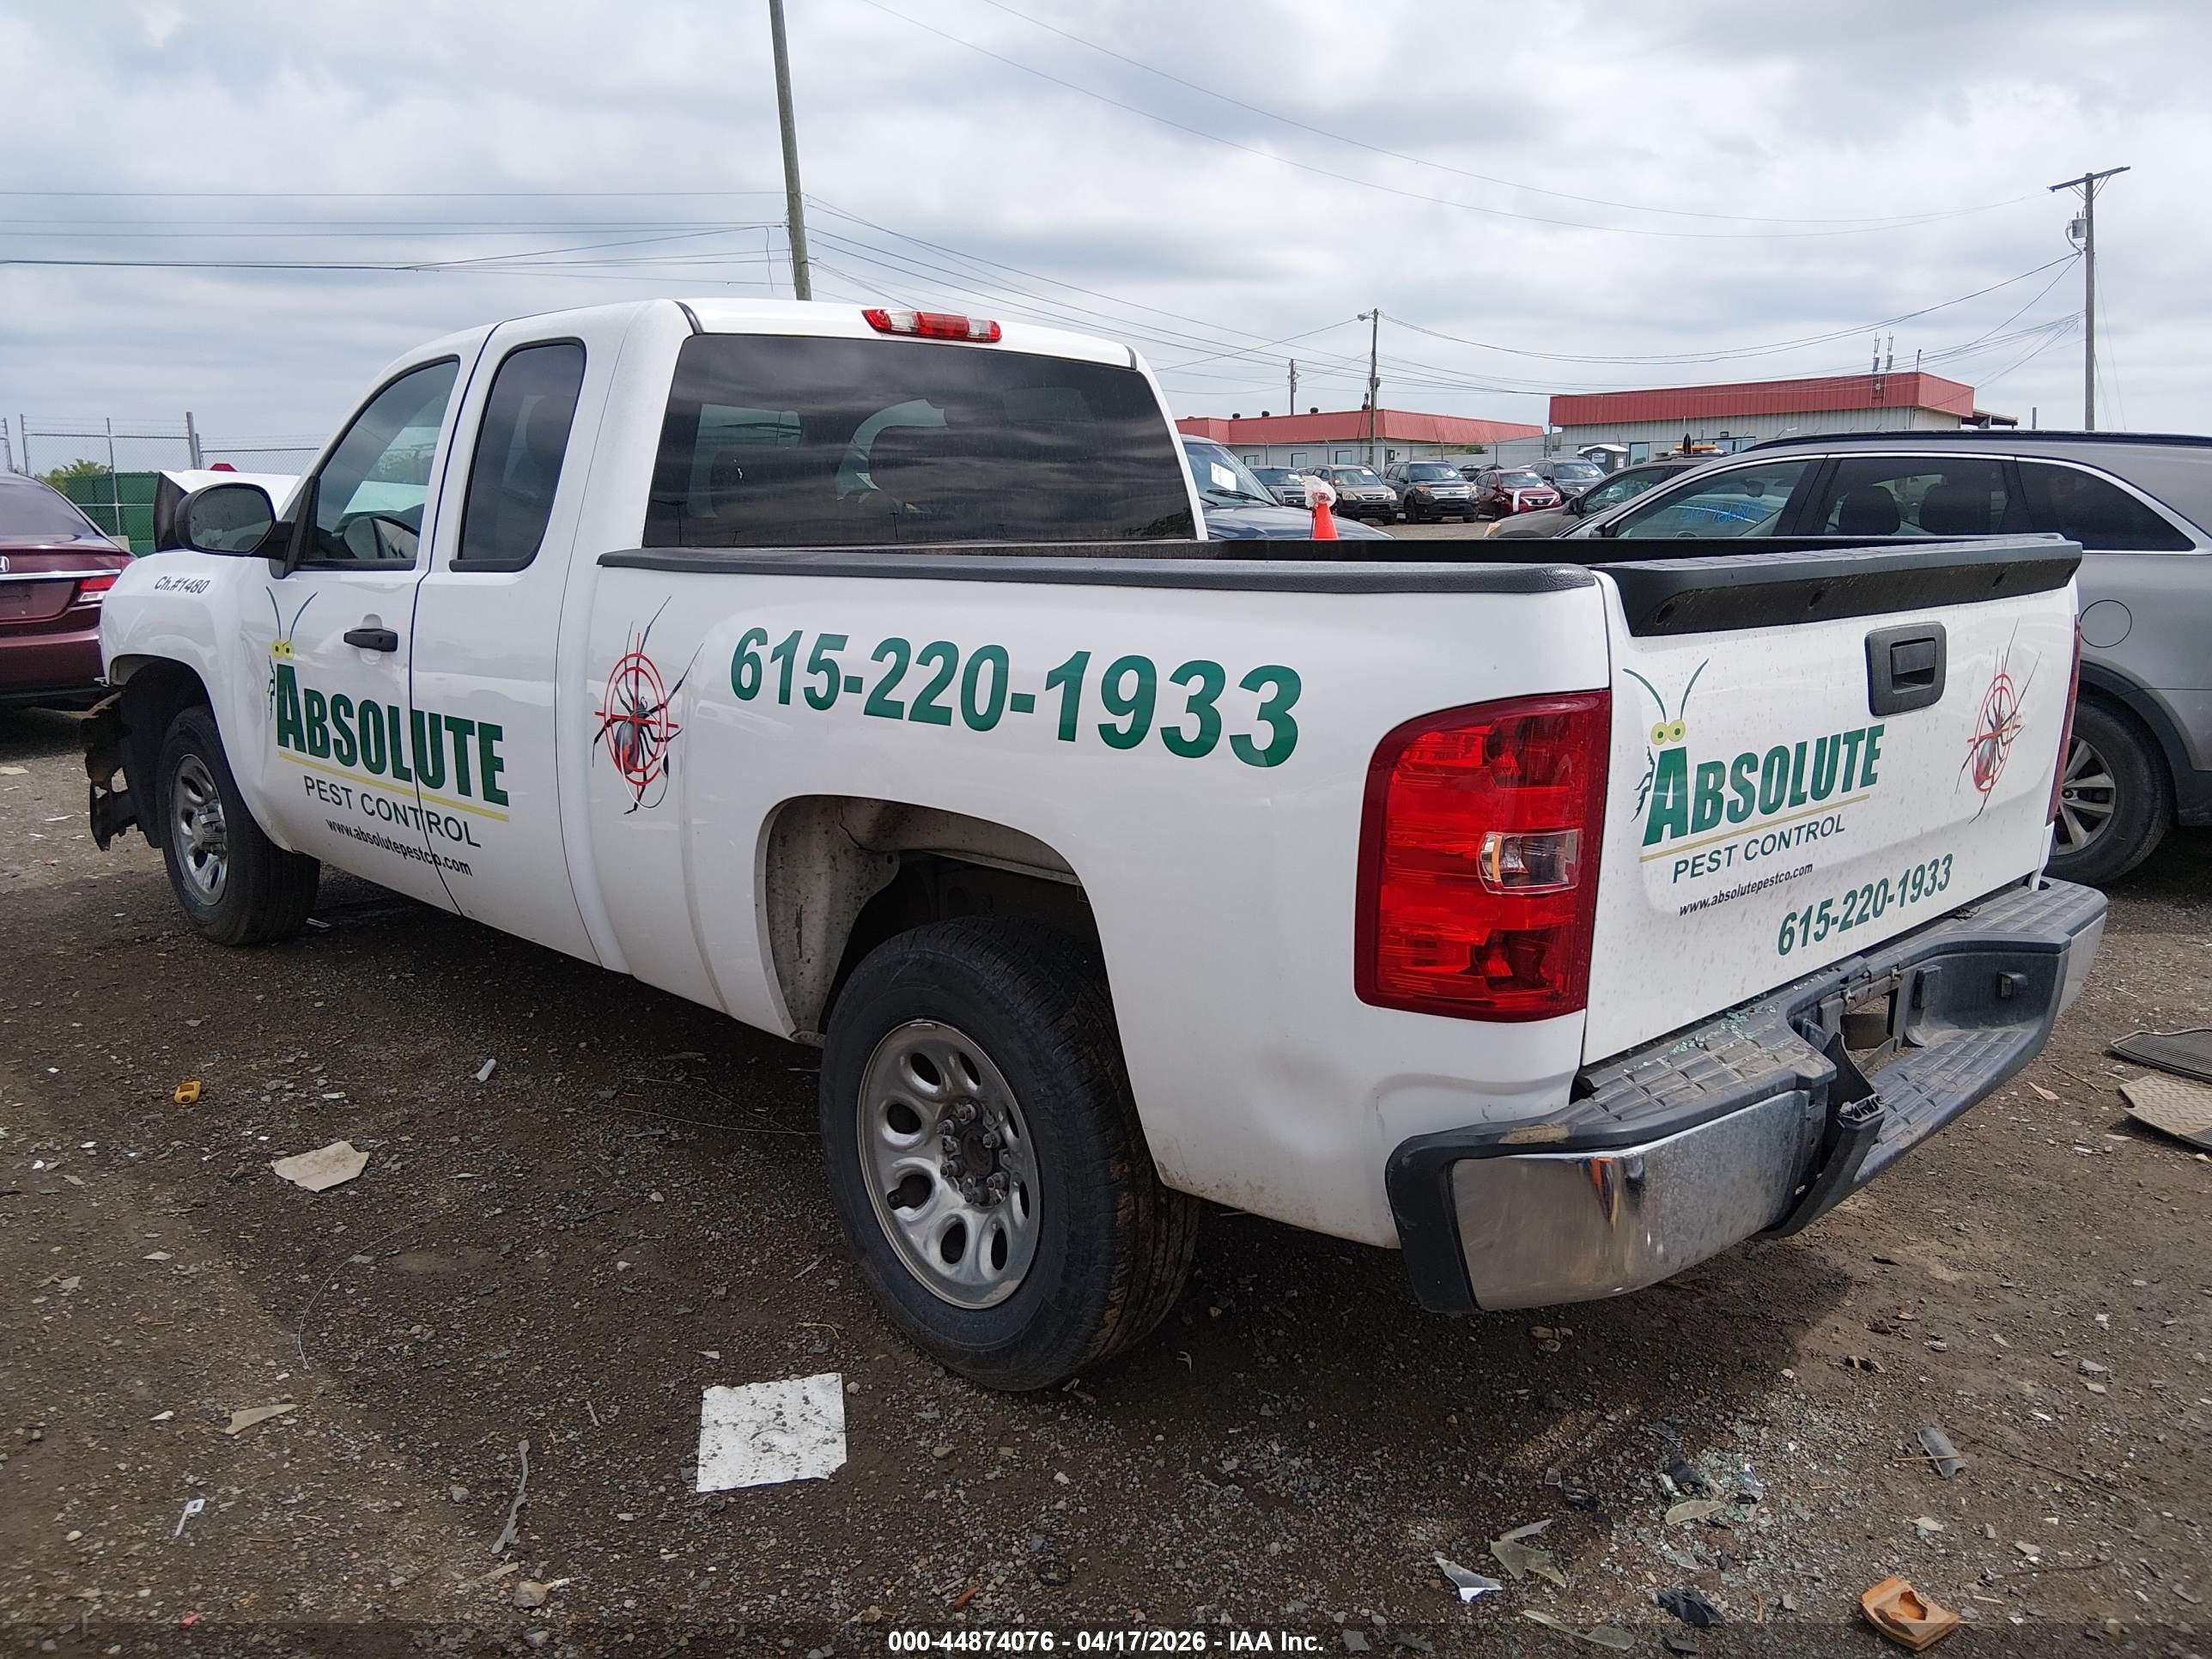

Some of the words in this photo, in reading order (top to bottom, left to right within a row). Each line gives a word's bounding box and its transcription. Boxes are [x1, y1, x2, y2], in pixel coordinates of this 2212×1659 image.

[276, 662, 509, 806] ABSOLUTE
[731, 627, 1303, 768] 615-220-1933
[303, 775, 352, 810] PEST
[360, 793, 482, 848] CONTROL
[1642, 724, 1885, 847] ABSOLUTE
[325, 818, 473, 878] www.absolutepestco.com
[1672, 844, 1738, 884] PEST
[1743, 814, 1845, 861] CONTROL
[1679, 863, 1814, 917] www.absolutepestco.com
[1777, 853, 1954, 957] 615-220-1933
